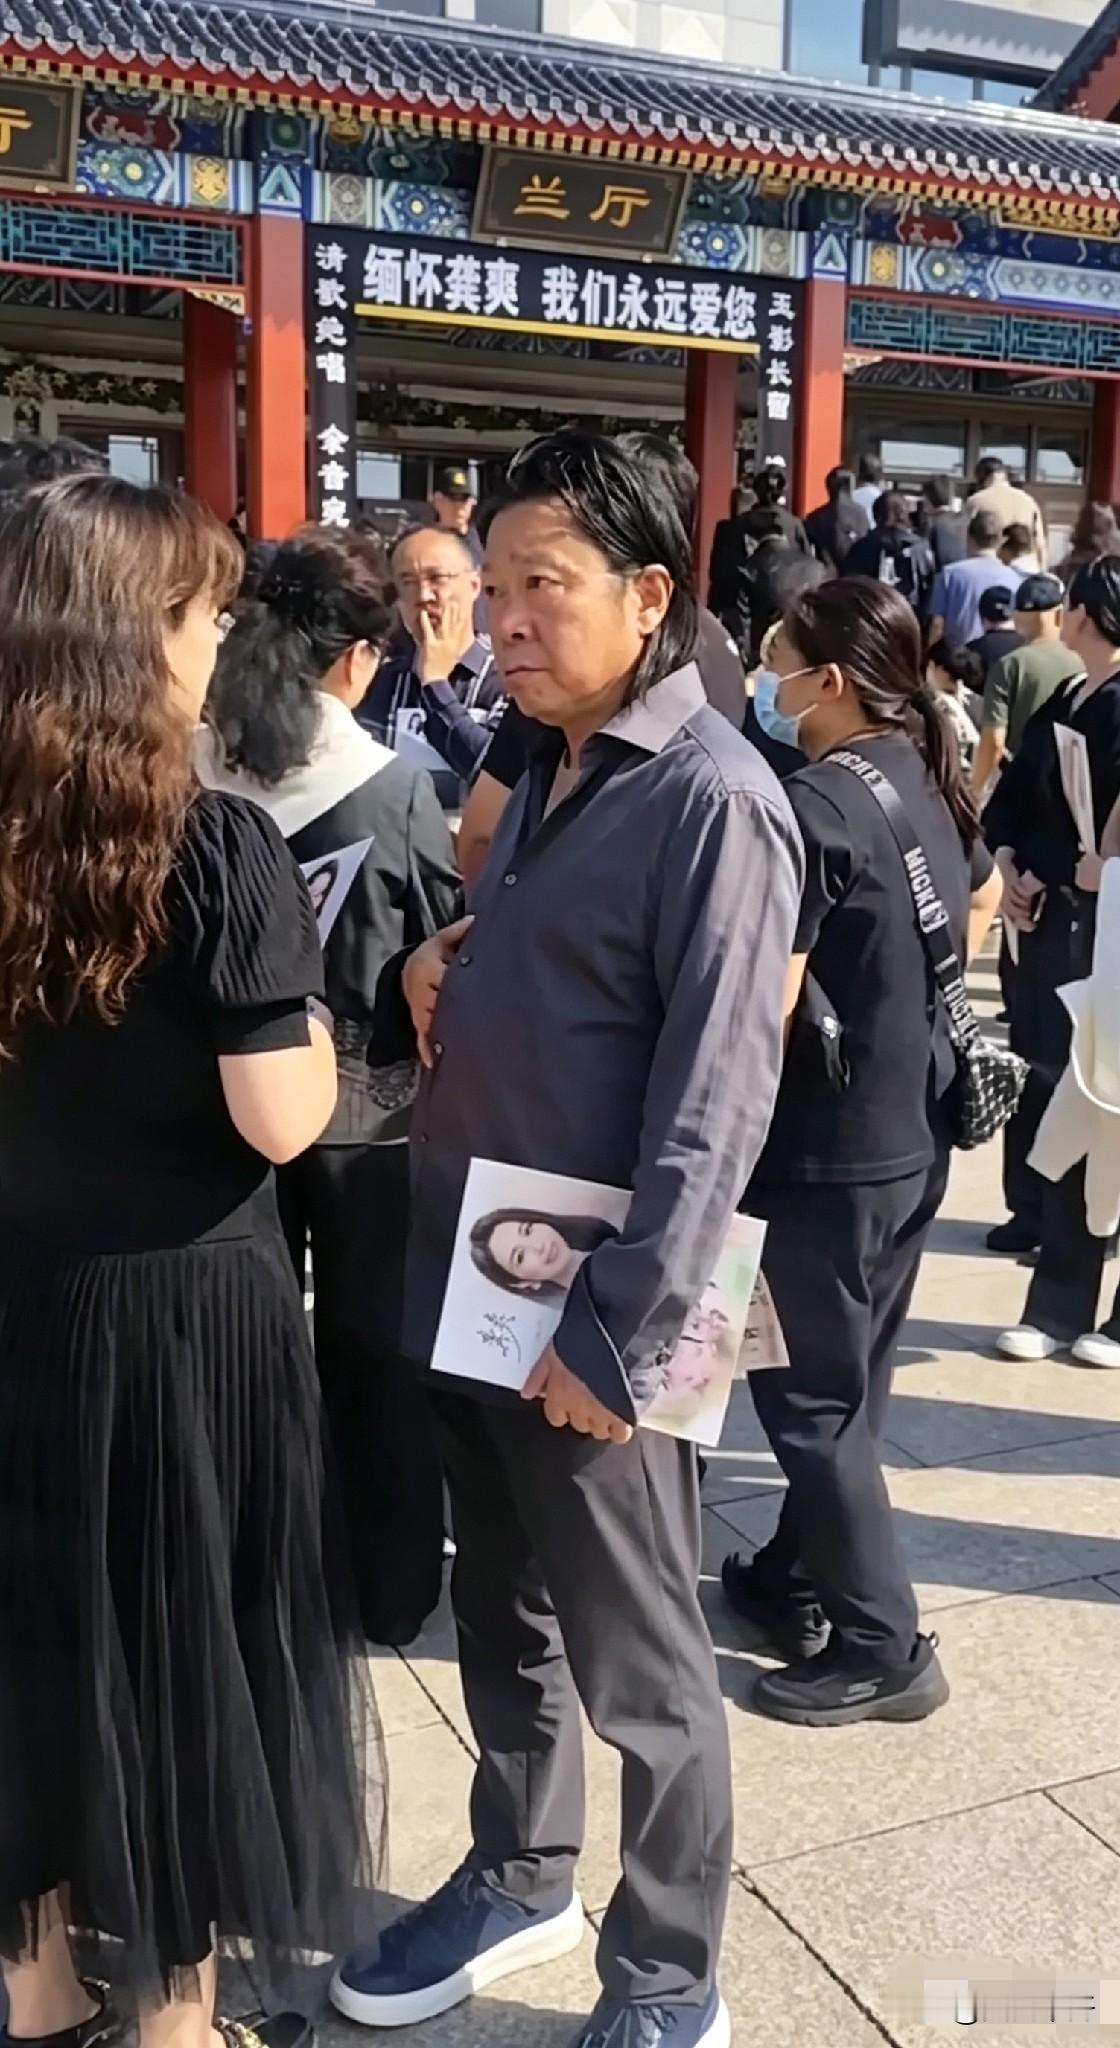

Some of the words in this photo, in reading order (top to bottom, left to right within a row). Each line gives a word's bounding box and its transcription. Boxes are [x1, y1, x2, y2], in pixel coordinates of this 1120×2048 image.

[513, 174, 651, 228] 兰厅
[363, 243, 520, 317] 缅怀龚爽
[541, 264, 758, 339] 我们永远爱您
